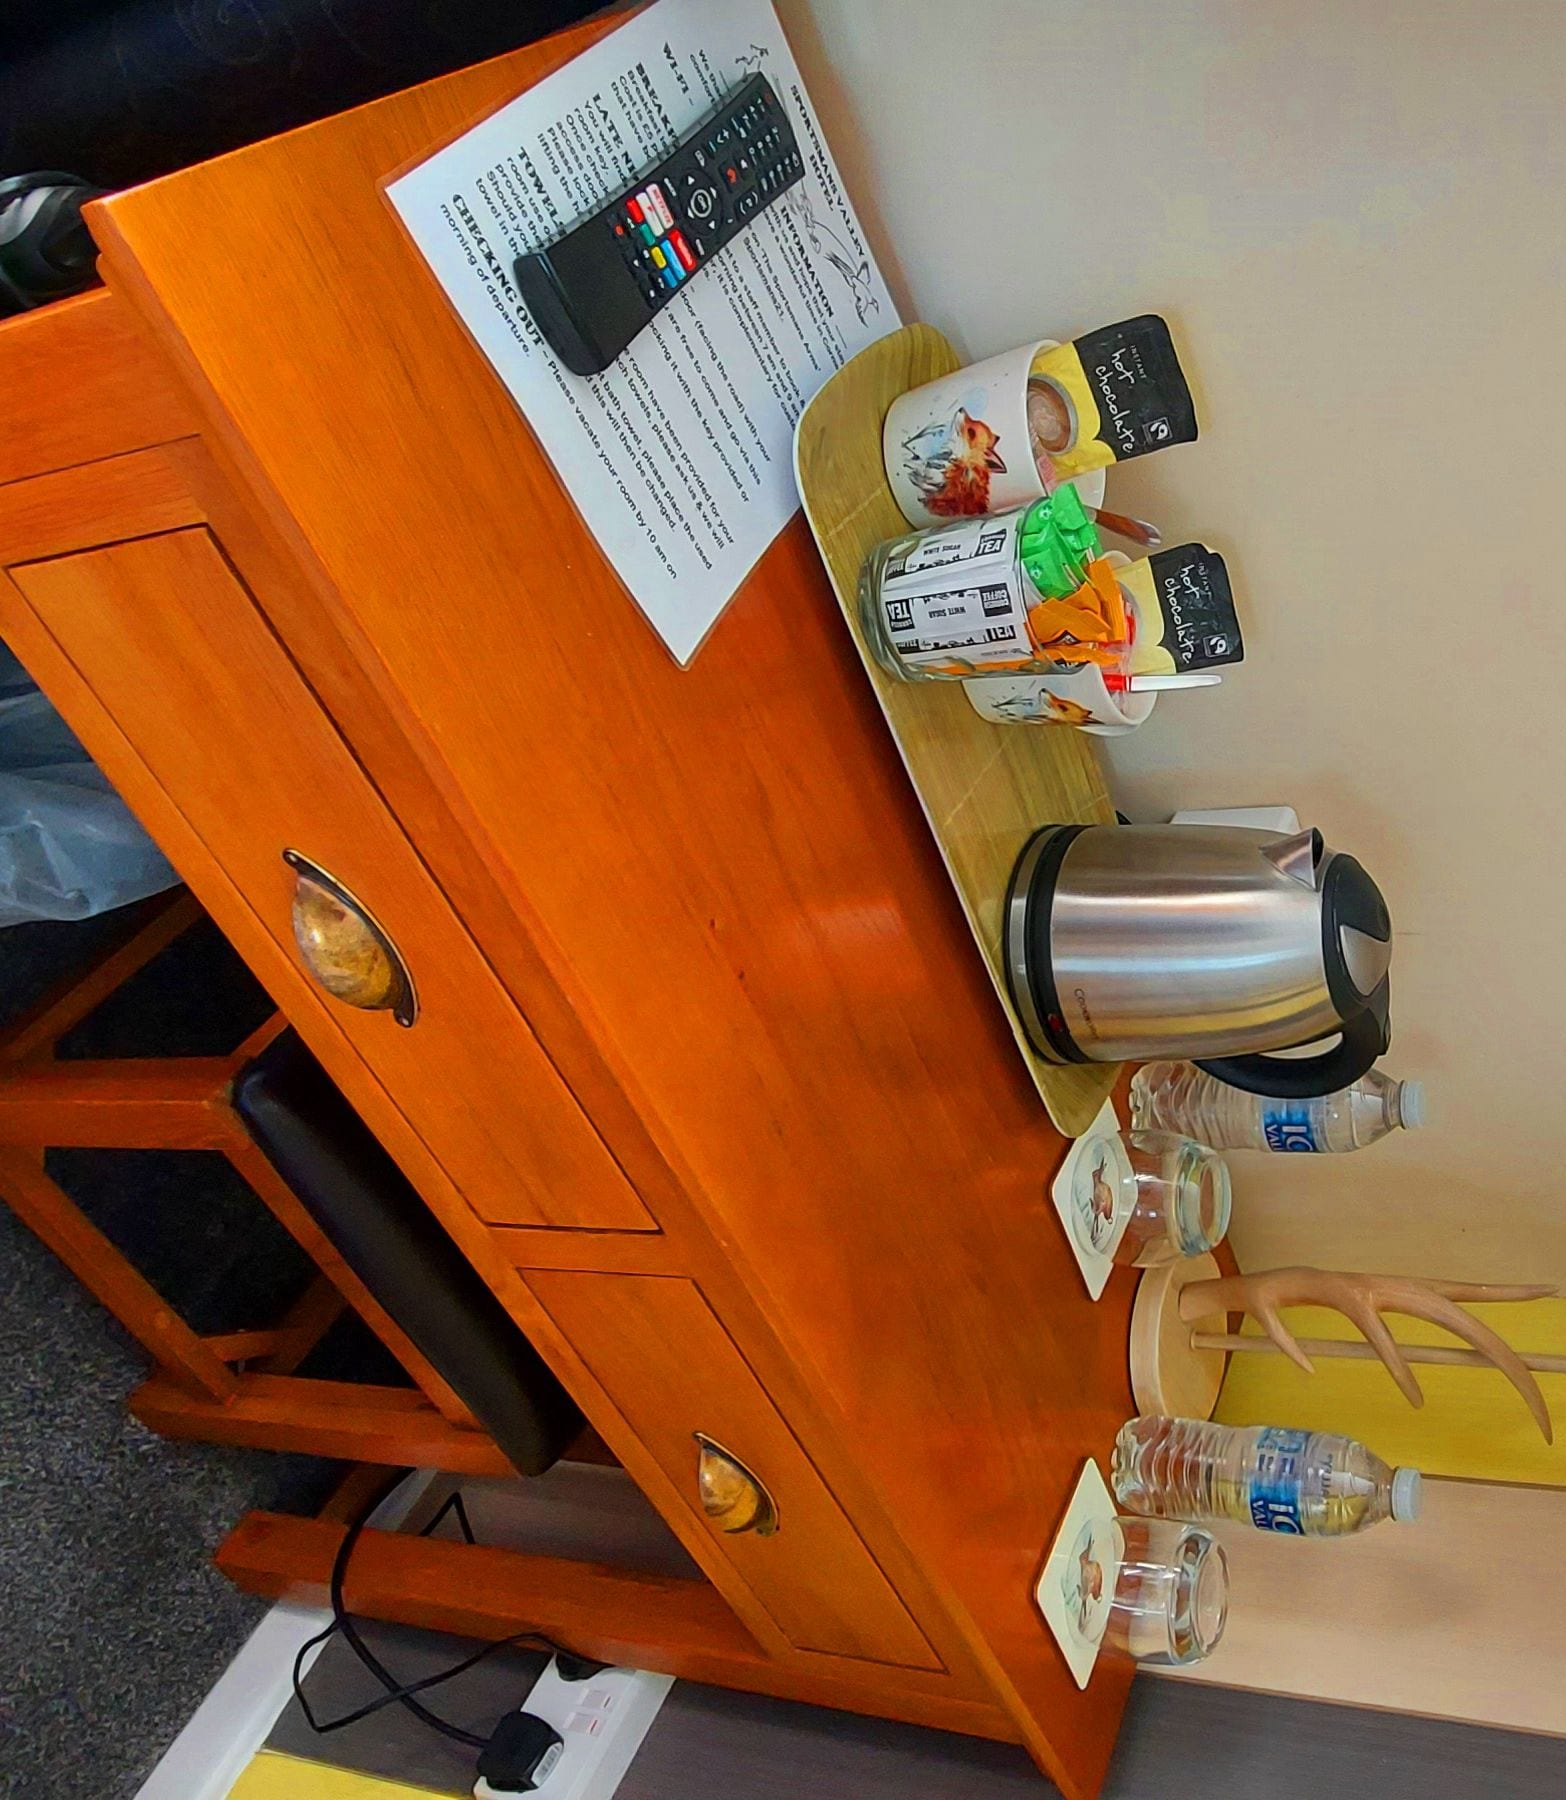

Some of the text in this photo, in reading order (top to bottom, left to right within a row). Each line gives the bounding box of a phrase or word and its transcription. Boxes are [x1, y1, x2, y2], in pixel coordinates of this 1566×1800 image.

[592, 92, 624, 150] LATE
[610, 81, 644, 144] that have
[698, 48, 710, 72] We
[708, 72, 725, 101] than
[494, 163, 529, 219] provide
[537, 132, 573, 200] lifting the
[555, 121, 600, 201] access doo
[573, 107, 610, 176] room key.
[689, 53, 717, 105] comfort
[779, 243, 807, 300] wonderful
[790, 84, 865, 257] SPORTSMANS VALLEY
[808, 153, 834, 212] HOTEL
[619, 75, 638, 109] Cost
[728, 297, 774, 383] complementary
[780, 401, 797, 434] custo
[627, 69, 662, 136] Breakfast
[737, 293, 763, 344] between
[635, 61, 679, 146] BREAKF
[743, 284, 760, 310] staff
[756, 311, 781, 356] member
[440, 203, 530, 357] morning of departure.
[565, 113, 587, 152] Once
[679, 334, 695, 360] free
[693, 359, 702, 374] to
[701, 375, 720, 407] come
[718, 408, 733, 431] and
[729, 430, 740, 447] go
[739, 446, 750, 465] via
[748, 463, 761, 486] this
[584, 99, 600, 129] You
[598, 129, 614, 154] will
[694, 320, 718, 362] (facing
[716, 360, 729, 382] the
[727, 382, 746, 414] road)
[743, 413, 758, 438] with
[754, 437, 772, 462] your
[780, 205, 835, 318] INFORMATION
[475, 177, 502, 219] towel
[498, 219, 510, 236] in
[591, 383, 607, 409] this
[605, 408, 621, 432] will
[618, 431, 637, 461] then
[635, 459, 646, 478] be
[645, 478, 677, 533] changed.
[506, 156, 530, 195] room
[528, 196, 544, 224] use
[651, 423, 676, 463] please
[674, 463, 689, 486] ask
[687, 484, 697, 501] us
[701, 510, 713, 530] we
[711, 528, 725, 550] will
[546, 126, 574, 175] Please
[645, 317, 672, 362] ocking
[670, 360, 678, 372] it
[676, 371, 692, 399] with
[690, 397, 703, 419] the
[701, 417, 716, 440] key
[712, 441, 744, 490] provided
[740, 490, 750, 503] or
[452, 194, 523, 304] CHECKING
[515, 305, 545, 346] OUT
[547, 359, 576, 405] Please
[575, 405, 601, 450] vacate
[597, 449, 619, 477] your
[616, 479, 637, 512] room
[635, 510, 647, 527] by
[646, 527, 657, 544] 10
[654, 544, 667, 564] am
[666, 563, 677, 580] on
[486, 170, 518, 222] Should
[602, 380, 621, 412] bath
[620, 410, 643, 451] towel,
[641, 449, 666, 490] please
[663, 490, 684, 523] place
[683, 521, 696, 542] the
[694, 542, 713, 571] used
[1095, 365, 1135, 454] chocolate
[1111, 348, 1135, 384] hot
[628, 357, 649, 390] room
[647, 389, 666, 421] have
[664, 419, 683, 452] been
[680, 451, 713, 502] provided
[709, 501, 721, 518] for
[716, 519, 735, 544] your
[979, 539, 1002, 554] TEA
[1180, 564, 1200, 600] hot
[887, 601, 911, 620] TEA
[928, 606, 967, 619] WHITE SUGAR
[1164, 577, 1195, 664] chocolate
